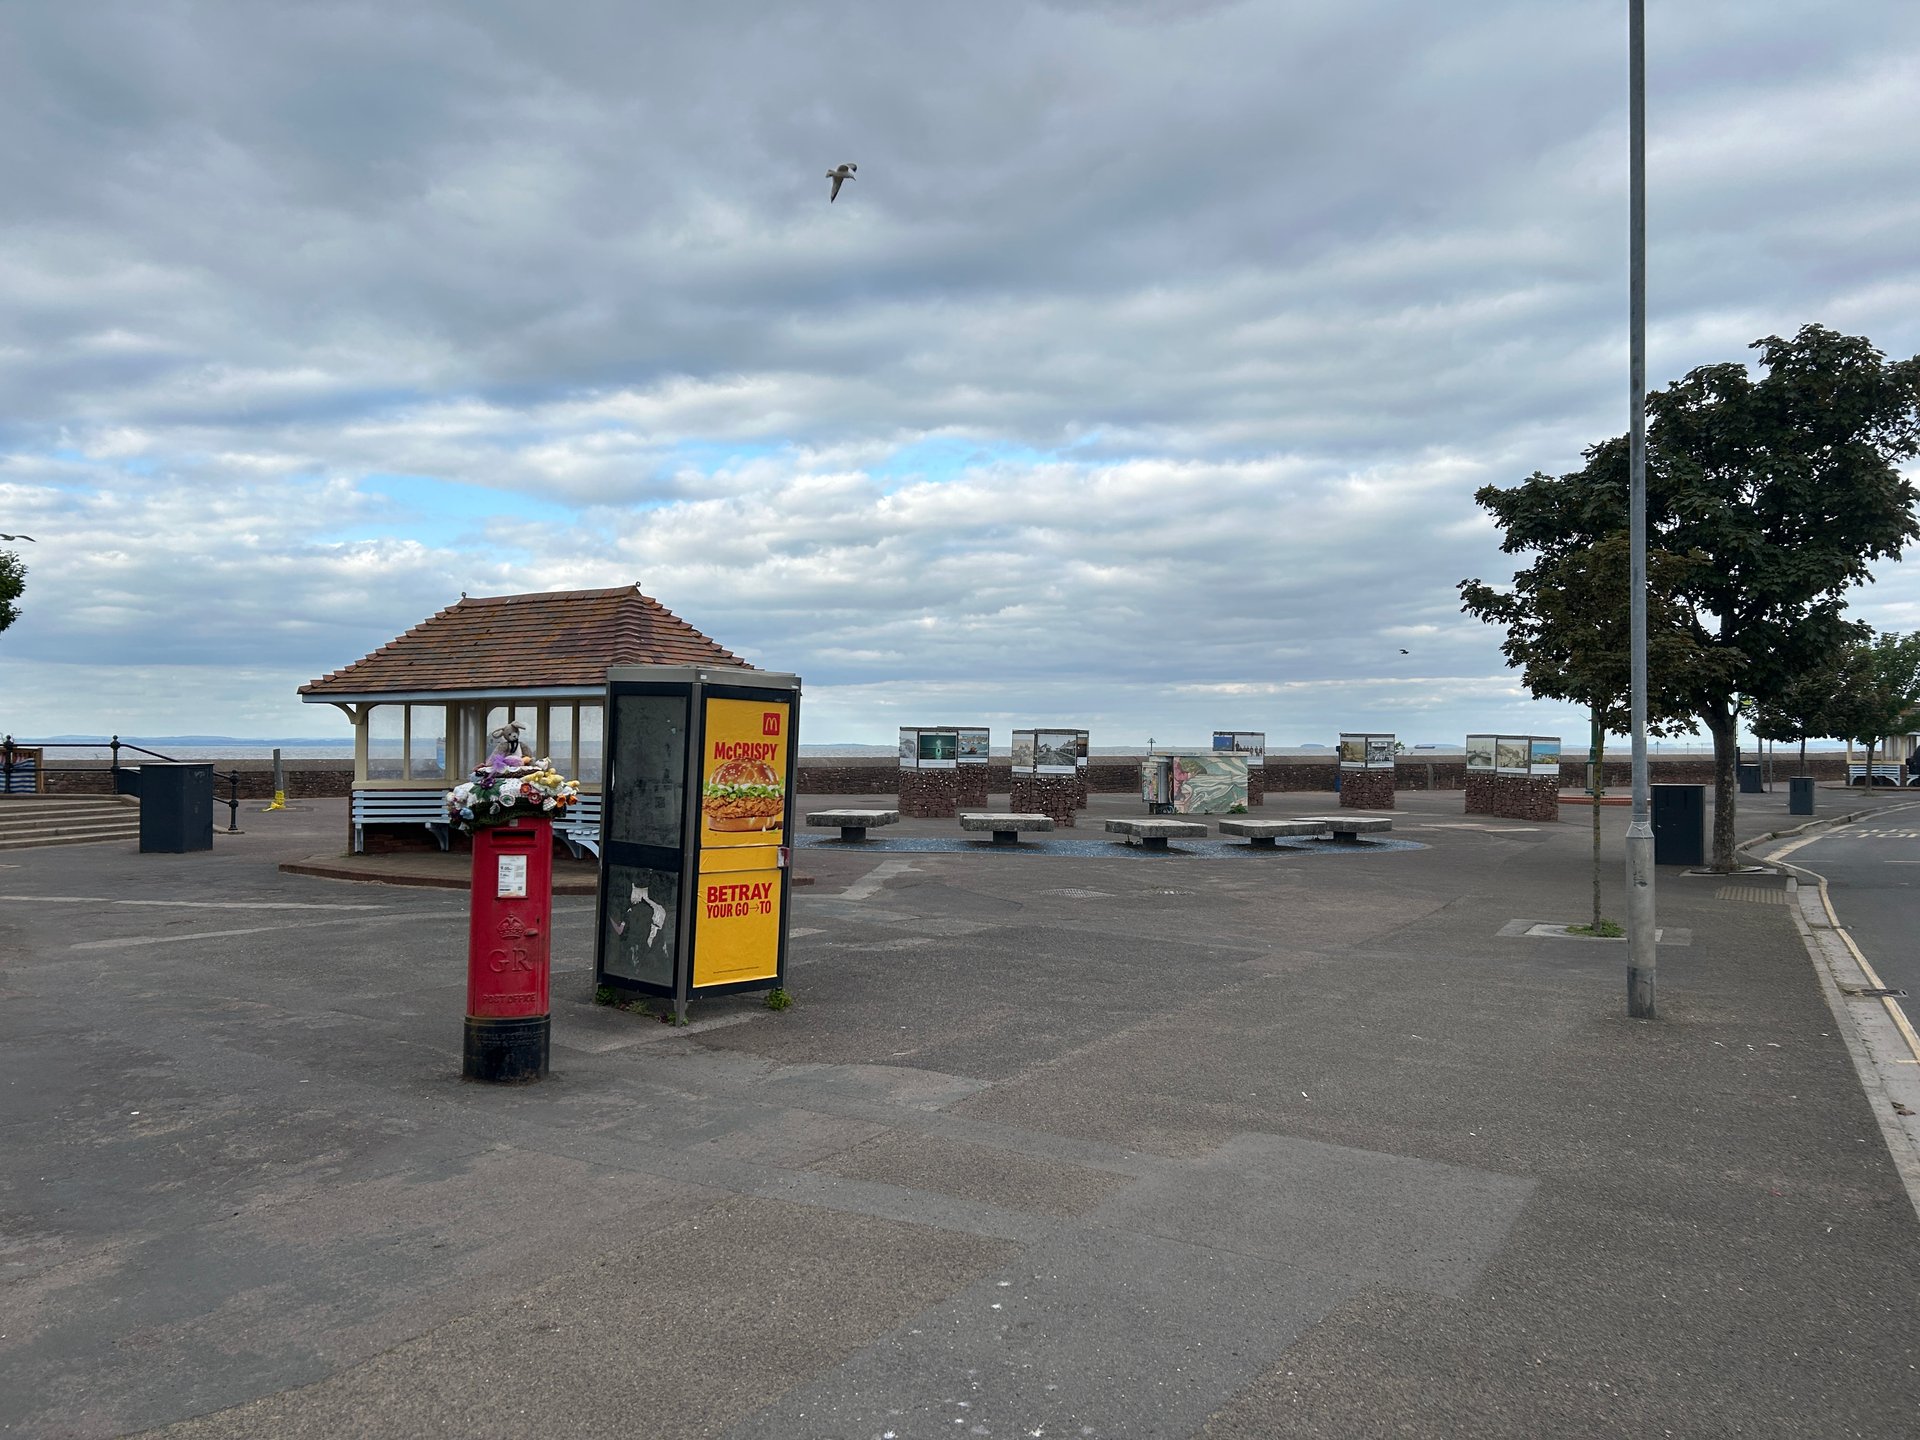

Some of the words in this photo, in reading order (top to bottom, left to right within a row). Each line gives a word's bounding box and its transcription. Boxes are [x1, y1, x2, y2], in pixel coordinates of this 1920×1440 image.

[714, 741, 779, 761] McCRISPY
[707, 882, 773, 904] BETRAY
[706, 903, 734, 919] YOUR
[735, 902, 749, 917] GO
[759, 900, 772, 915] TO
[488, 948, 533, 973] GR
